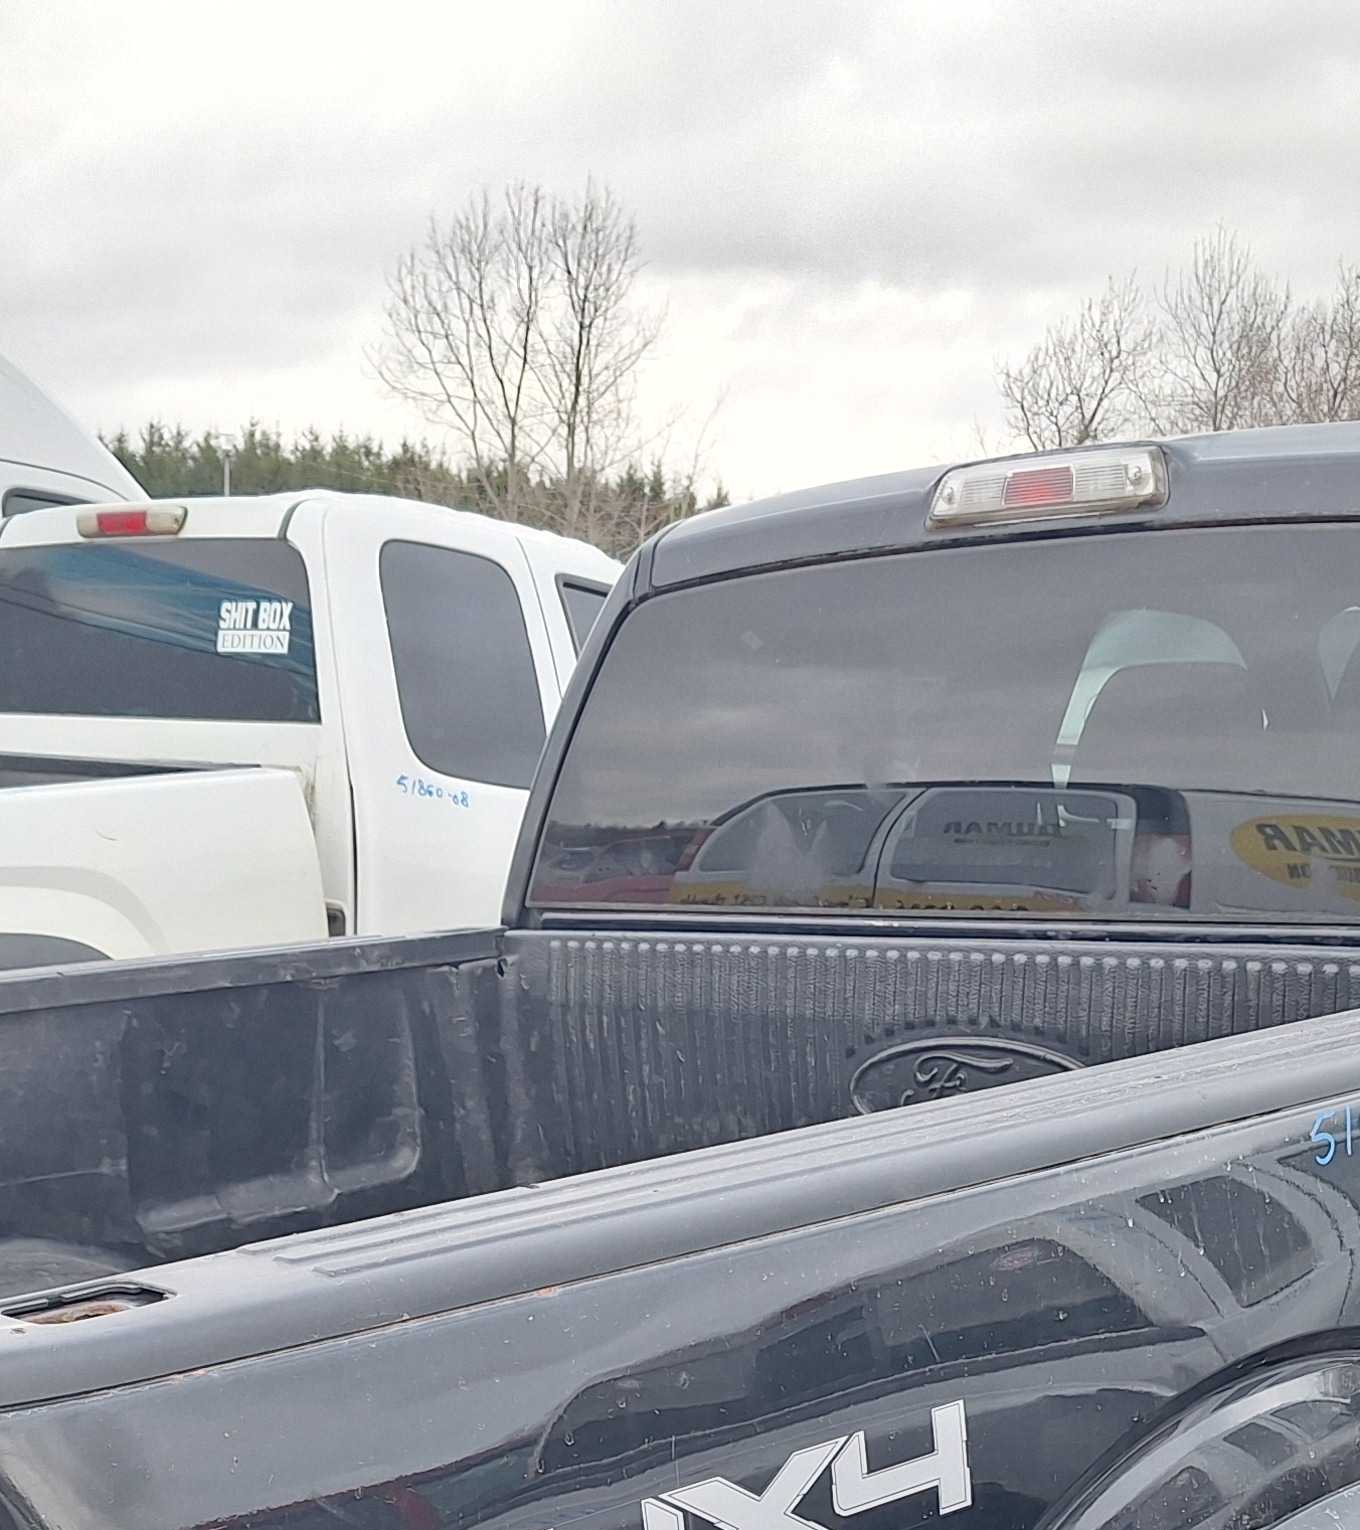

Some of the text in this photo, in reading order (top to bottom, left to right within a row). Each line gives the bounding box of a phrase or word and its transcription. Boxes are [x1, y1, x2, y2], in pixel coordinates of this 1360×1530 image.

[219, 601, 294, 630] SHIT BOX
[222, 633, 285, 649] EDITION
